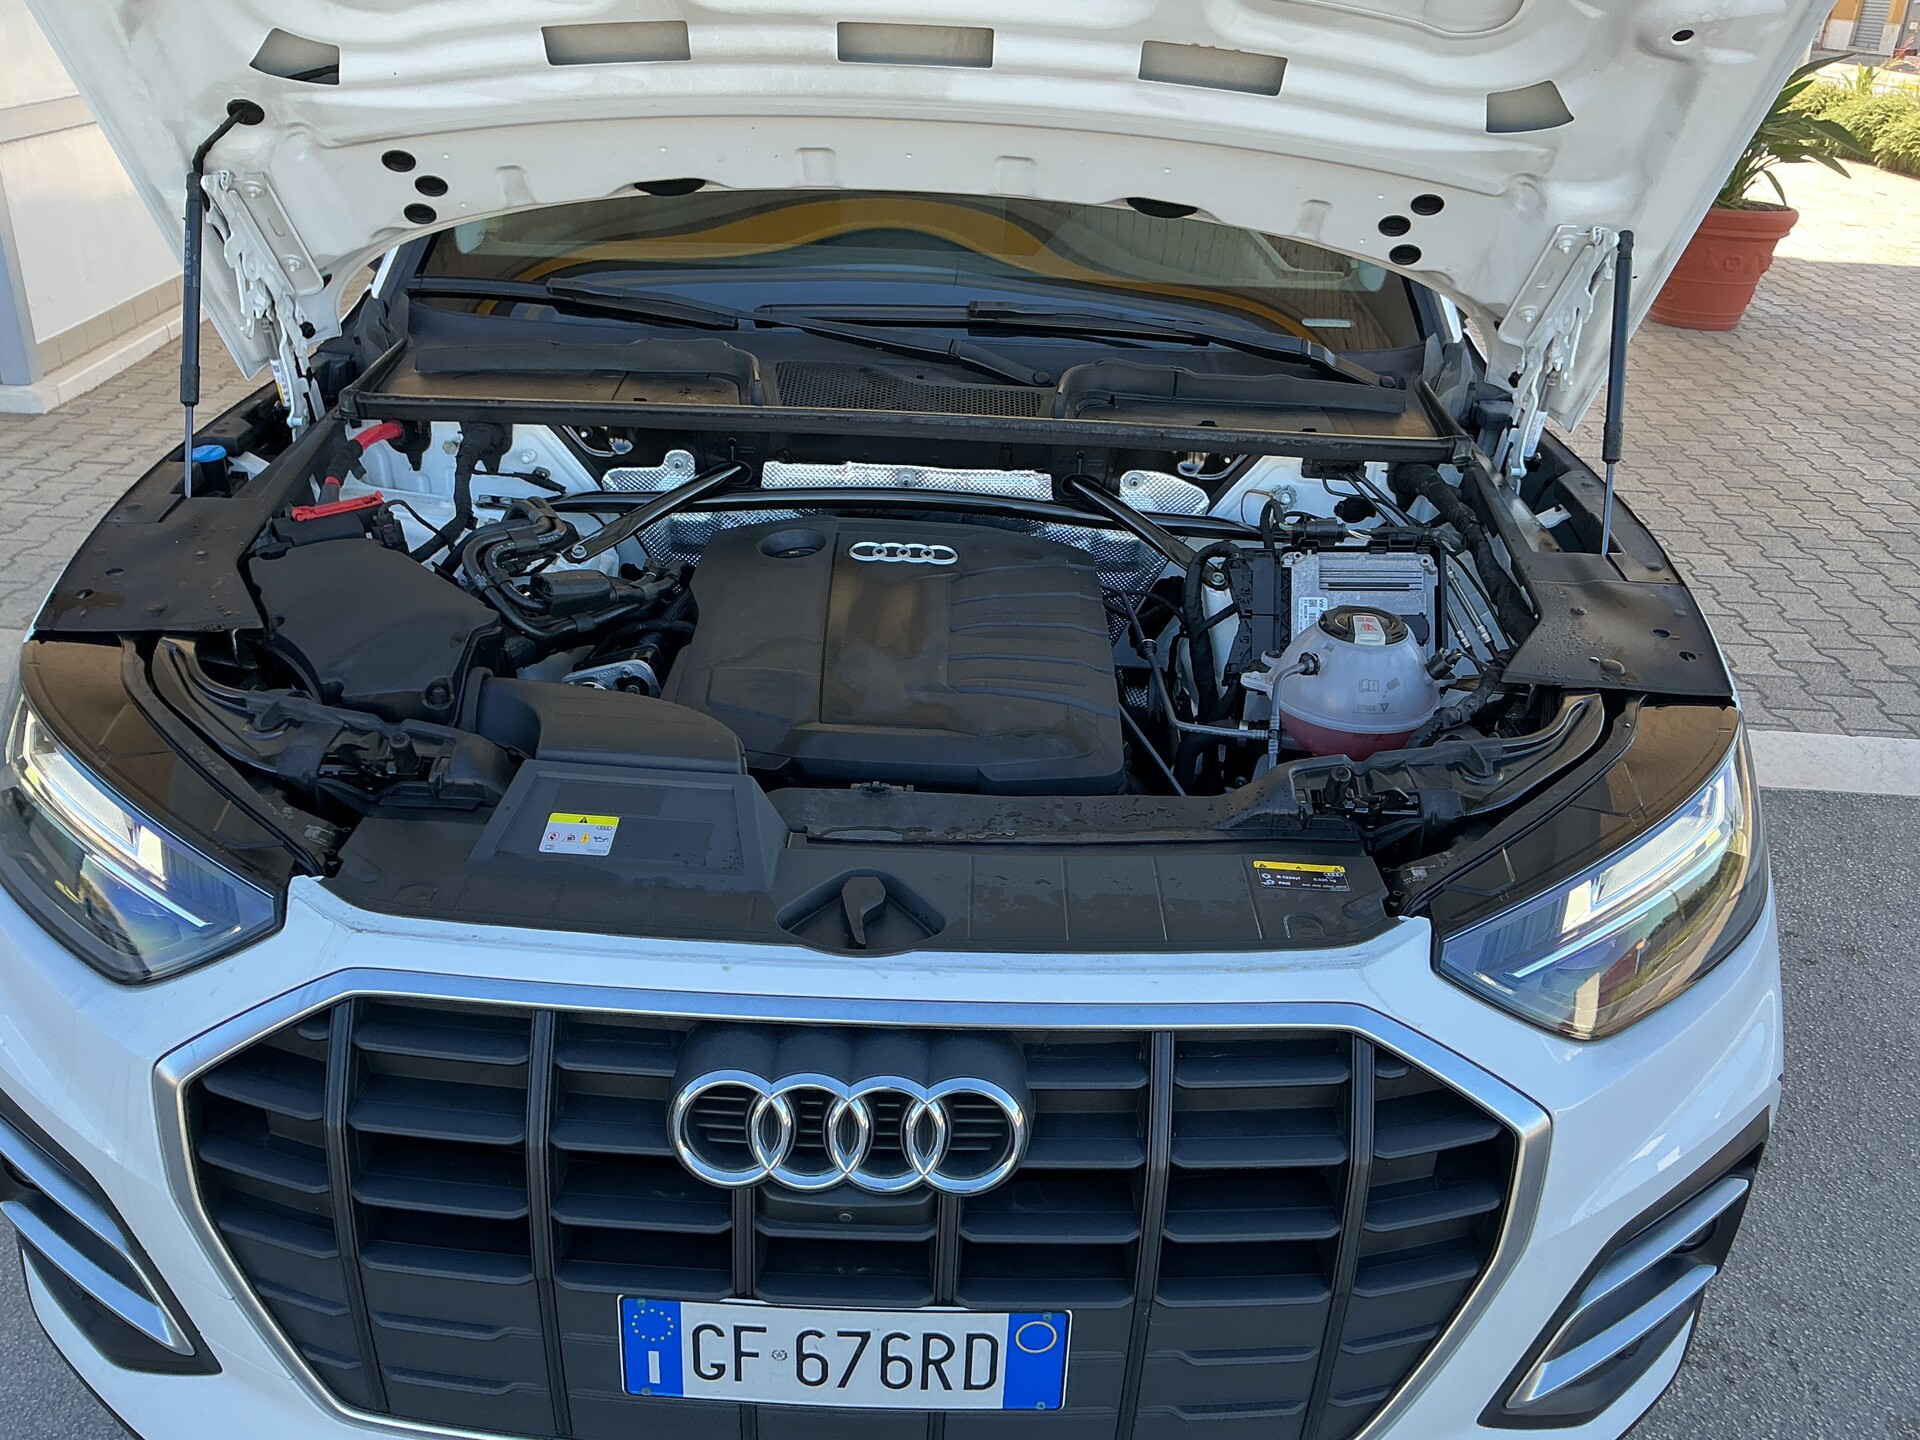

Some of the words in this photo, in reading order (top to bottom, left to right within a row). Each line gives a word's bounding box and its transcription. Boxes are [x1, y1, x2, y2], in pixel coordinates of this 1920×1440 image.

[1357, 703, 1377, 712] max
[648, 1350, 660, 1384] I
[691, 1324, 767, 1382] GF
[795, 1329, 999, 1391] 676RD
